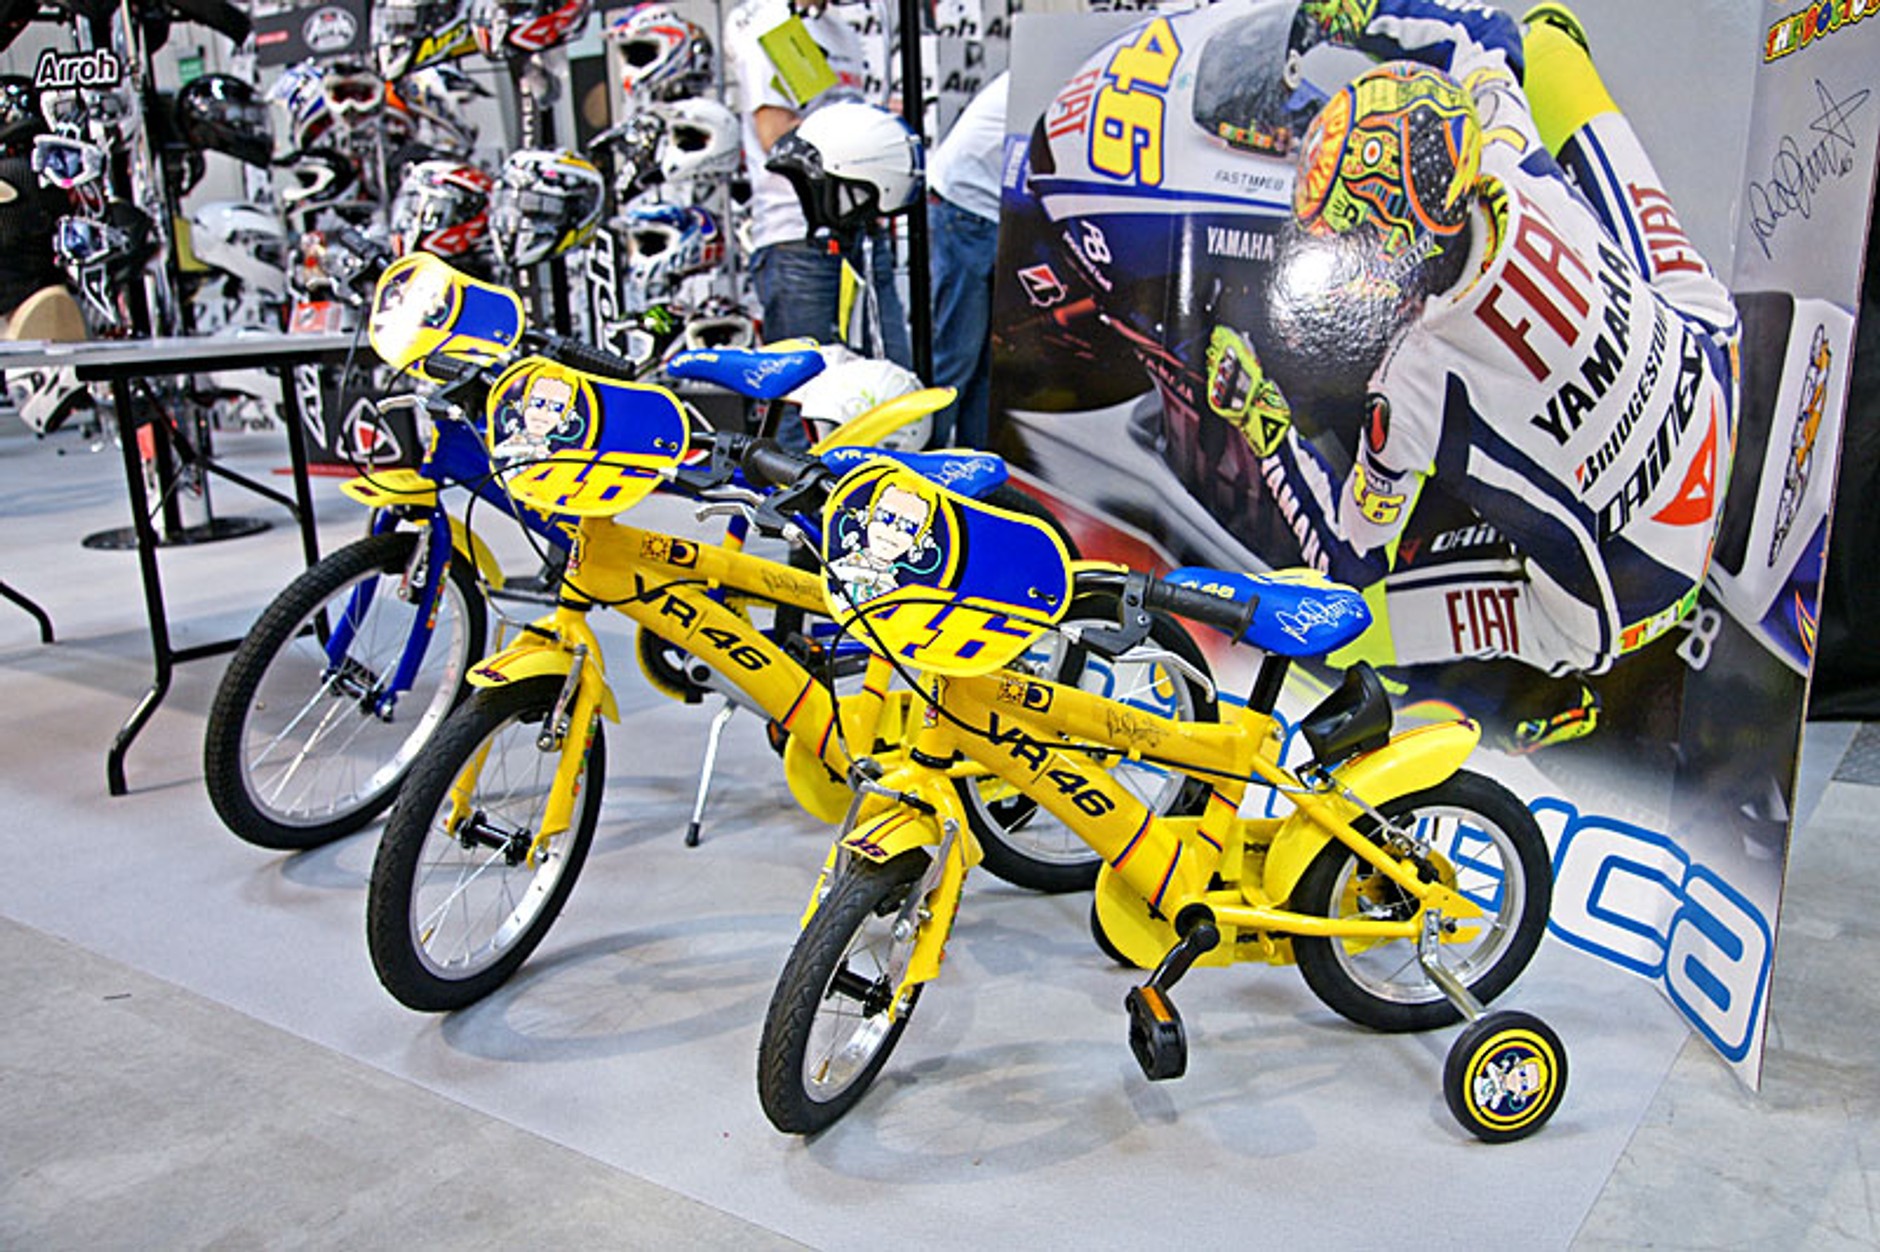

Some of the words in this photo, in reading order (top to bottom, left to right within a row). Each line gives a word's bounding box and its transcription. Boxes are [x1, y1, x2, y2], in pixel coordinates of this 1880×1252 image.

[1049, 68, 1102, 140] FIAT
[1087, 16, 1182, 187] 46
[1207, 225, 1277, 262] YAMAHA
[1628, 183, 1704, 274] FIAT
[1530, 242, 1632, 447] YAMAHA
[505, 450, 676, 512] 46
[699, 625, 772, 672] 46
[841, 583, 1055, 672] 46
[1446, 588, 1520, 655] FIAT
[984, 711, 1049, 772] VR
[1046, 768, 1115, 818] 46
